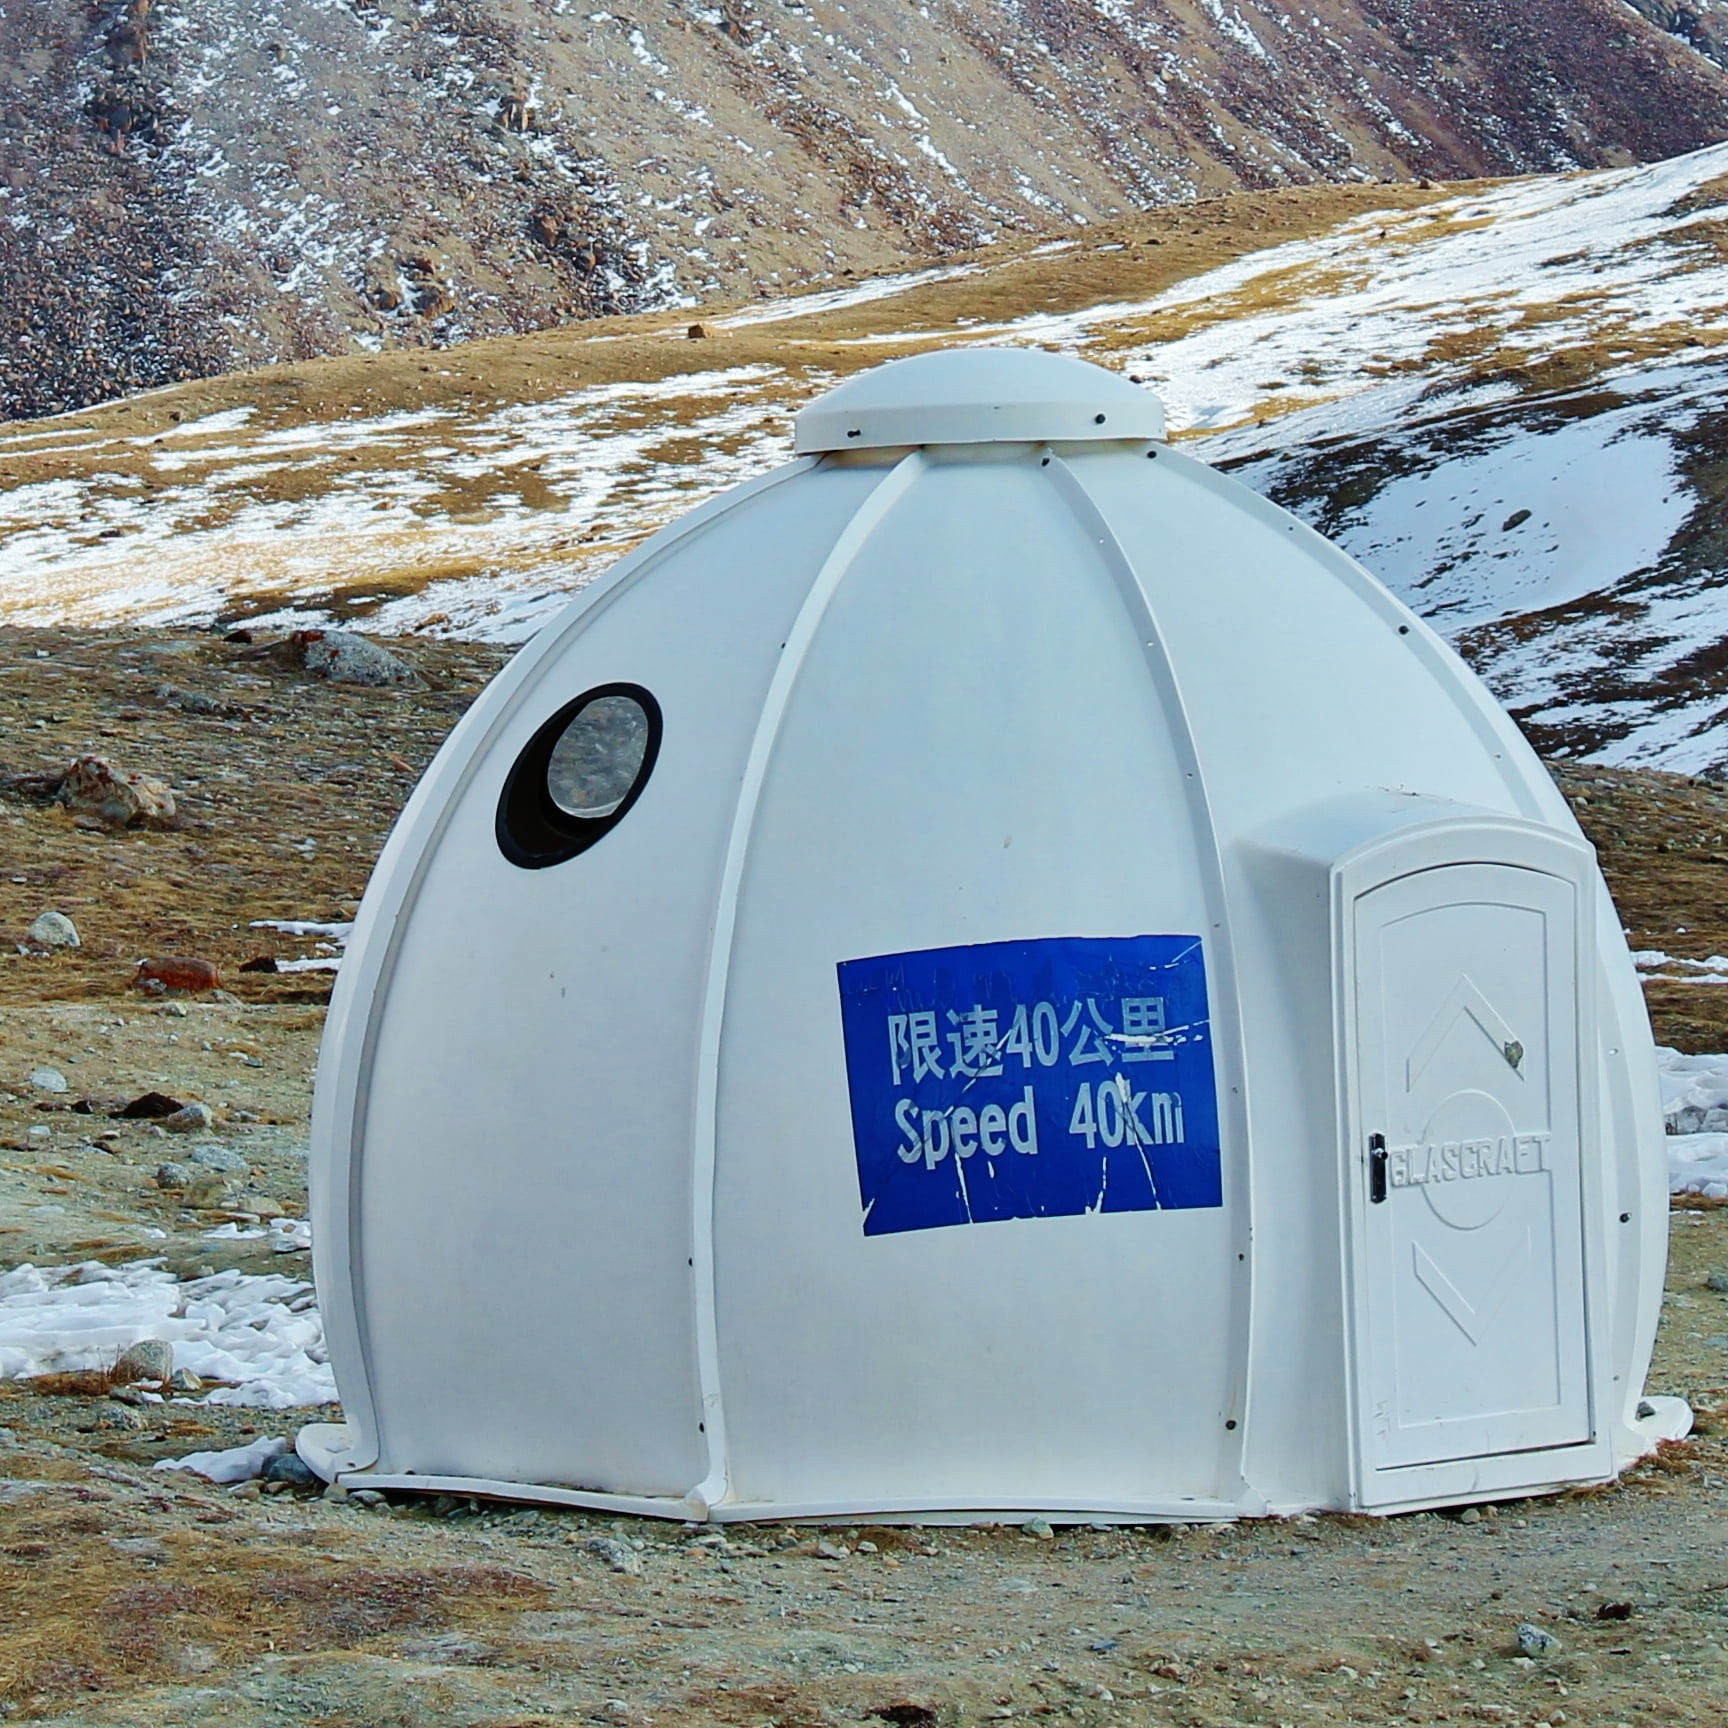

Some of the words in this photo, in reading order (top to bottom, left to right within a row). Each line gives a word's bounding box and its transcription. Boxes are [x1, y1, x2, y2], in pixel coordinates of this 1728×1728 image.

[888, 997, 1174, 1085] 限速40公里
[895, 1085, 1038, 1170] Speed
[1069, 1078, 1184, 1149] 40km
[1389, 1132, 1551, 1188] GLASCRAFT
